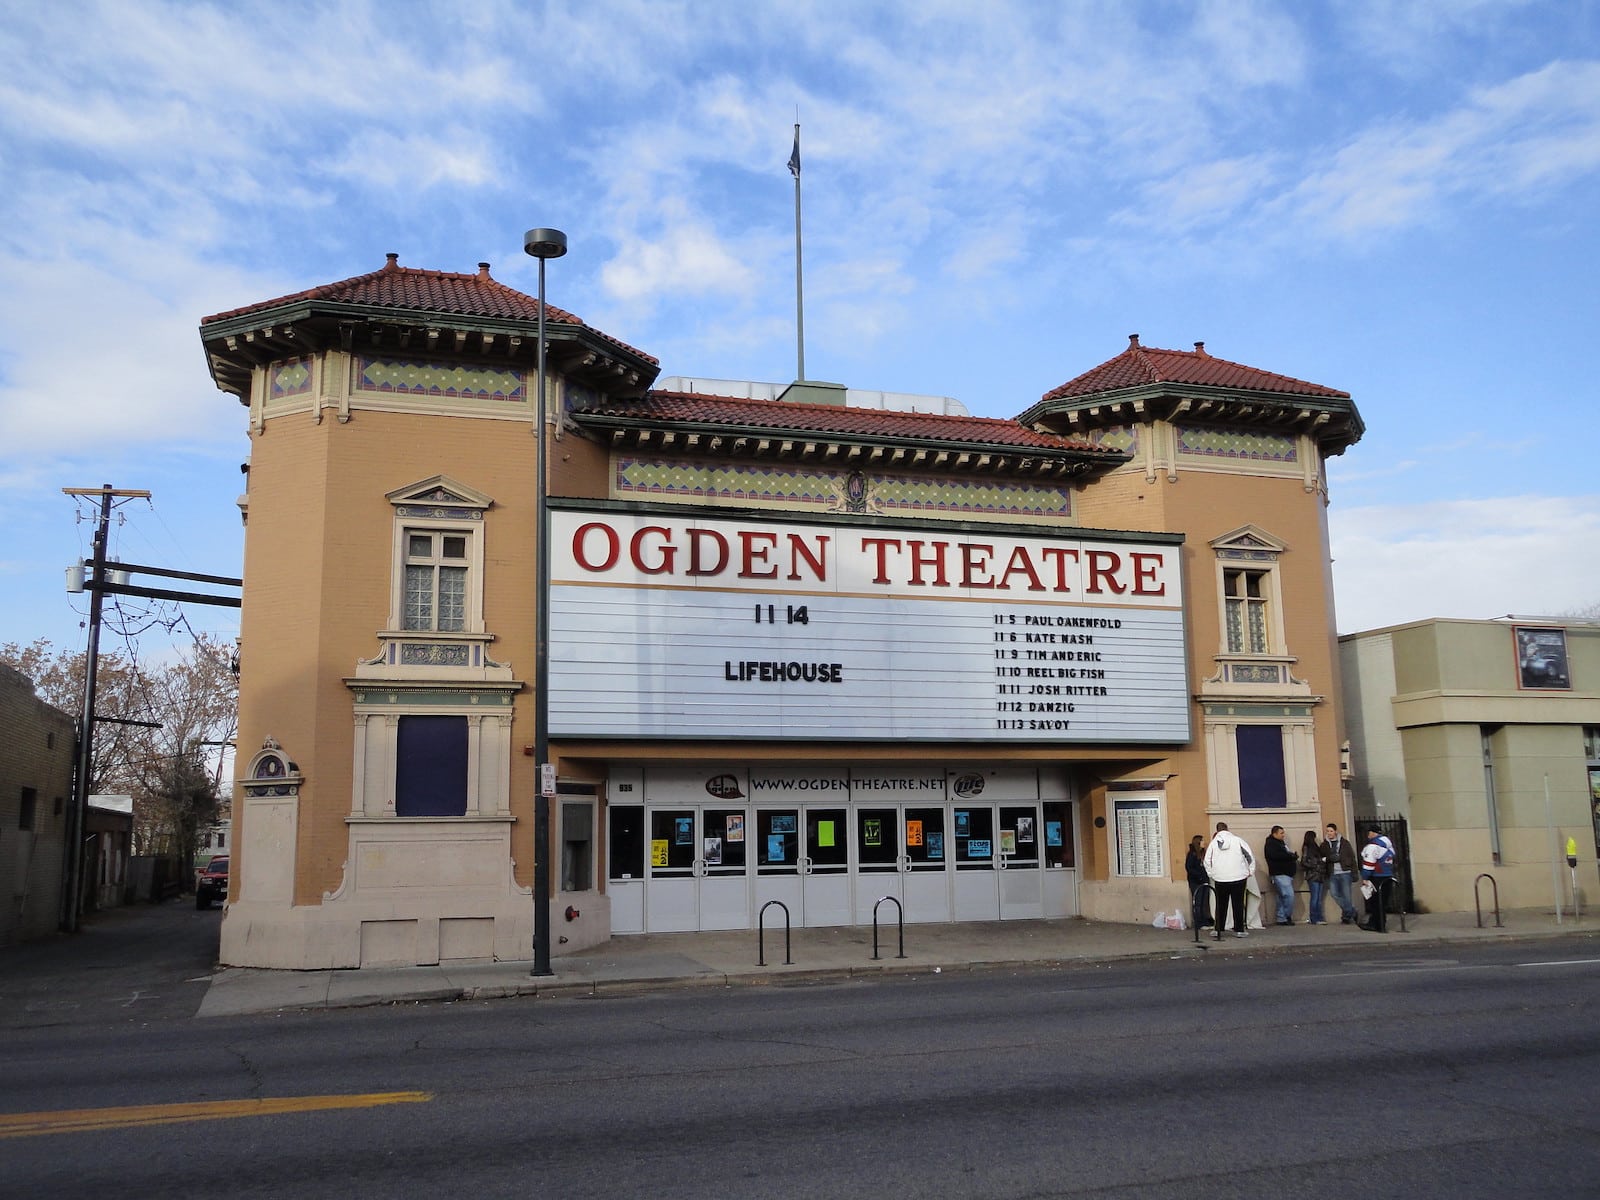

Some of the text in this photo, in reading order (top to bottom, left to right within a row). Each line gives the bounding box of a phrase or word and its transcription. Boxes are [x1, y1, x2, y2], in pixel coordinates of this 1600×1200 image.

[572, 522, 1166, 596] OGDEN THEATRE
[755, 604, 809, 625] 11 14
[994, 614, 1122, 629] 11 5 PAUL OAKENFOLD
[995, 632, 1093, 645] 11 6 KATE NASH
[995, 649, 1101, 662] 11 9 TIM AND ERIC
[725, 661, 843, 683] LIFEHOUSE
[996, 666, 1105, 679] 11 10 REEL BIG FISH
[999, 684, 1108, 696] 11 11 JOSH RITTER
[998, 701, 1075, 713] 11 12 DANZIG
[997, 719, 1070, 730] 11 13 SAVOY
